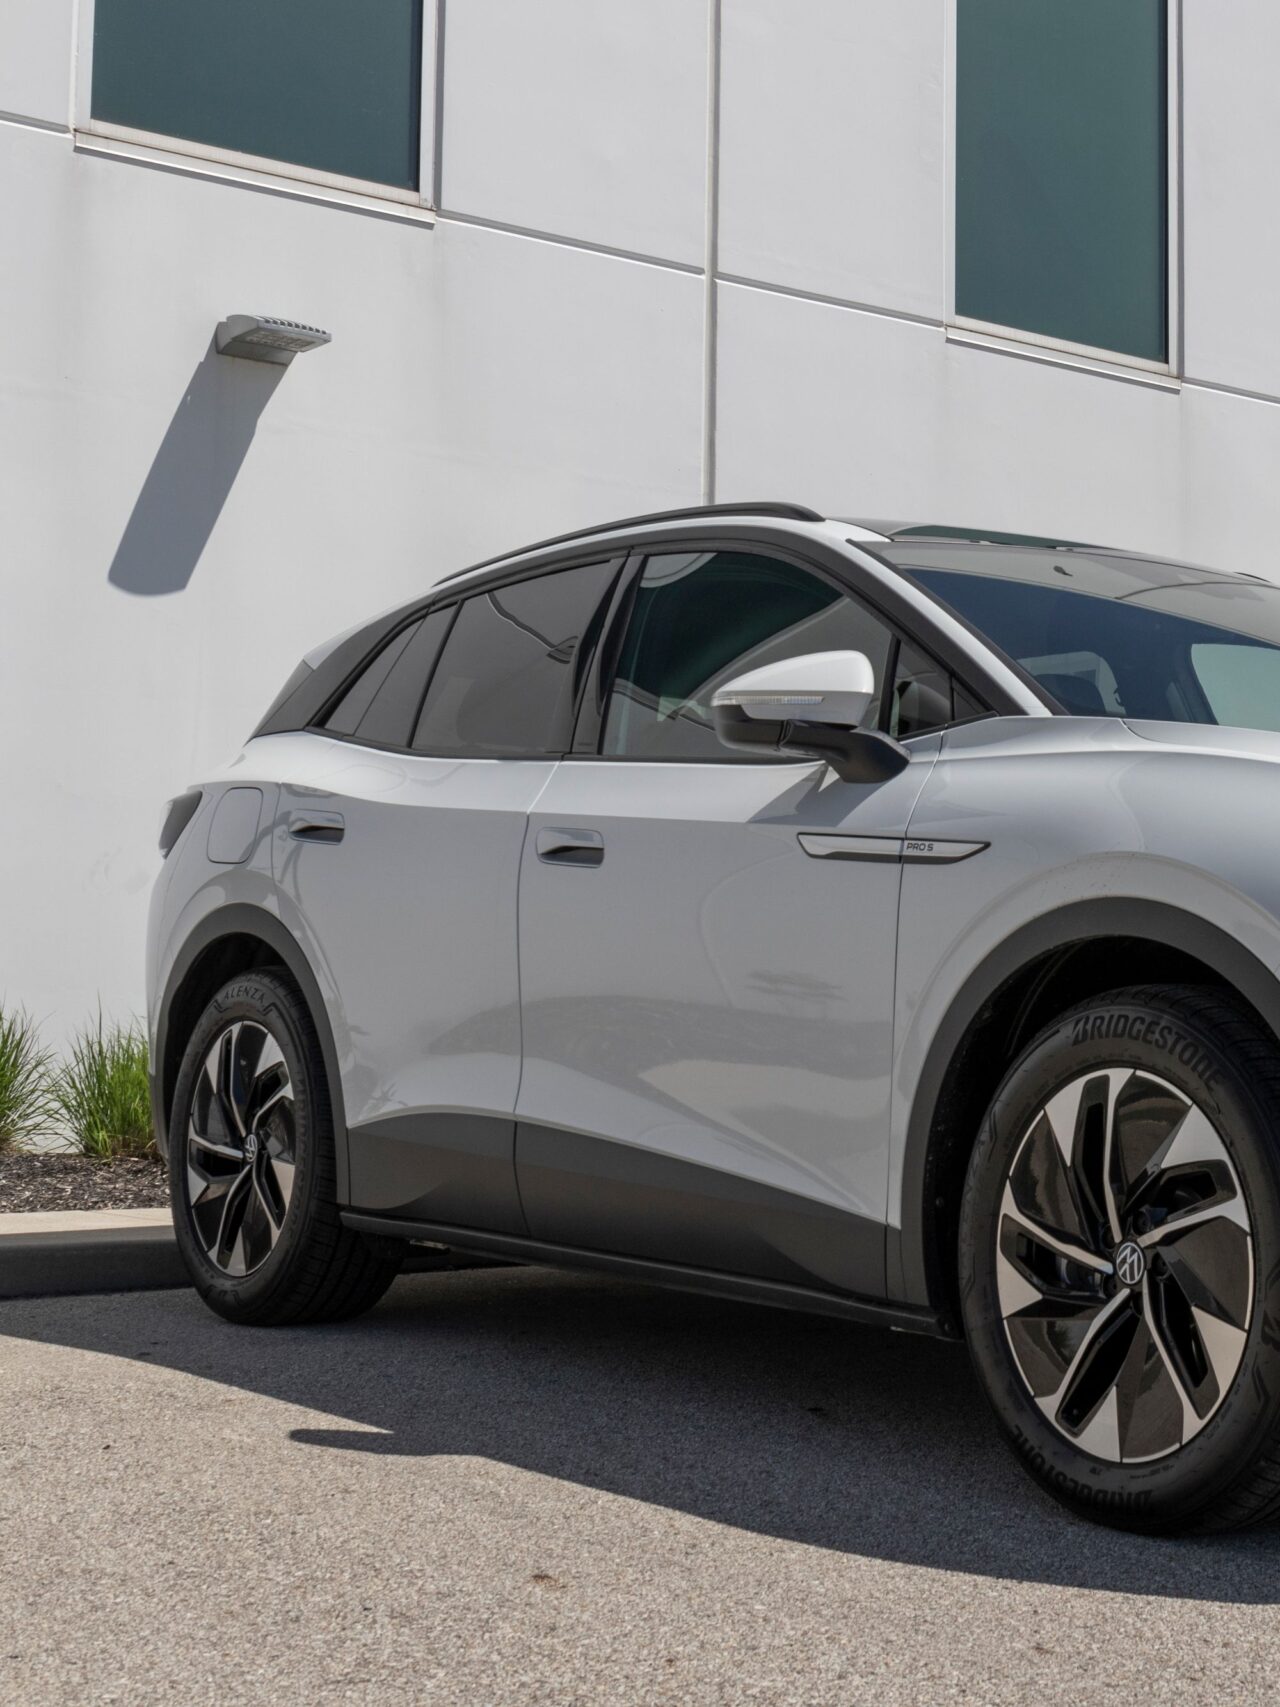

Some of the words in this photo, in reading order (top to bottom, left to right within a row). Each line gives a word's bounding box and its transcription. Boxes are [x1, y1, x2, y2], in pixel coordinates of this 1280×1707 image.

[906, 842, 926, 851] PRO
[927, 843, 934, 852] S
[224, 986, 265, 1004] ALENZA
[1072, 1014, 1224, 1088] BRIDGESTONE
